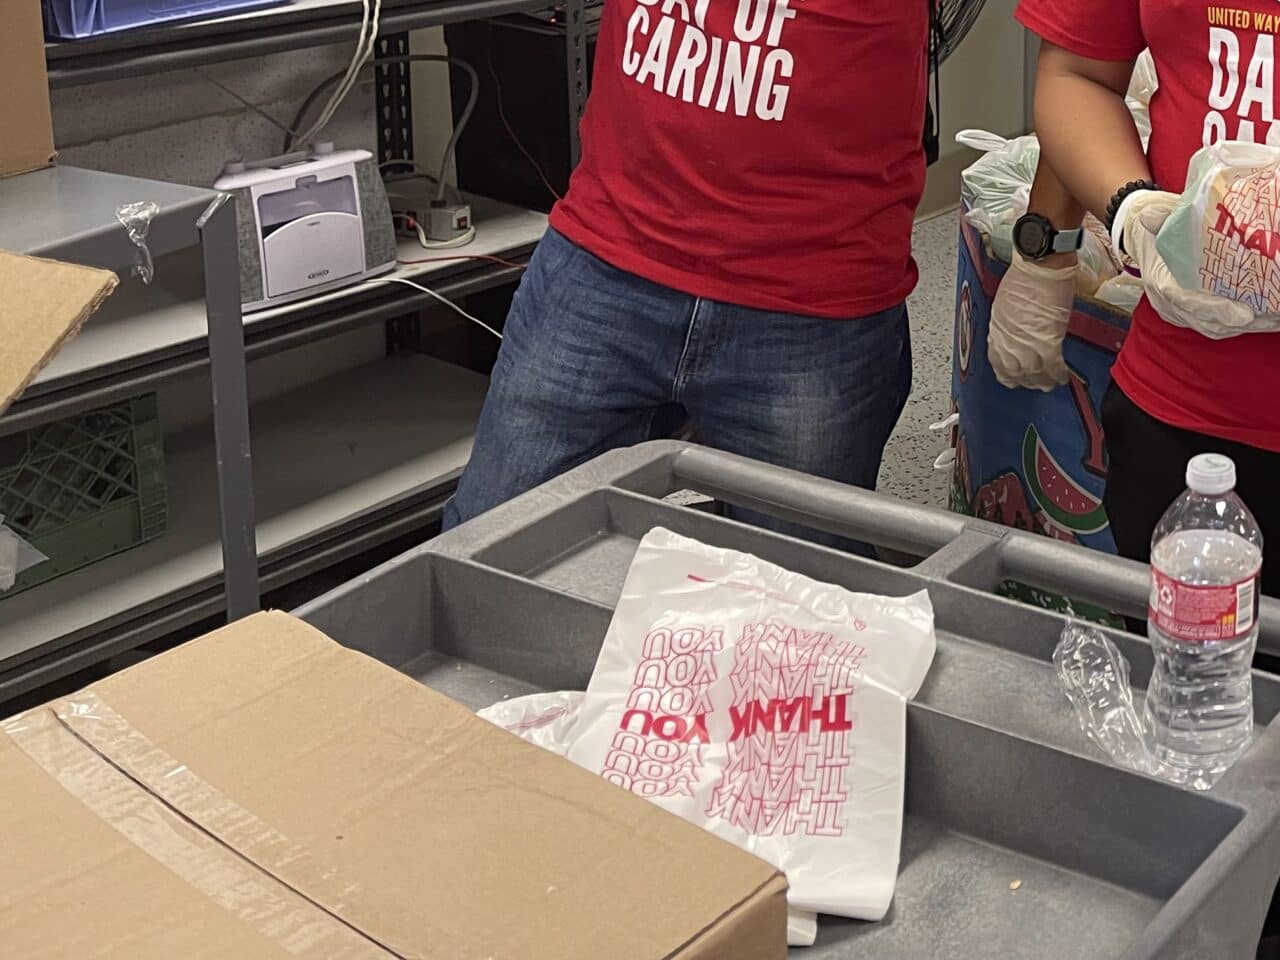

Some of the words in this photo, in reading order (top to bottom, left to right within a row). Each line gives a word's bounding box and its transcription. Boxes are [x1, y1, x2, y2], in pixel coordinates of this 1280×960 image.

[1207, 6, 1251, 29] UNITED
[622, 5, 794, 122] CARING
[642, 627, 725, 660] YOU
[634, 651, 719, 689] YOU
[626, 685, 715, 717] YOU
[729, 694, 854, 742] THANK
[619, 709, 711, 744] YOU
[604, 749, 700, 783] YOU
[612, 731, 704, 768] YOU
[726, 729, 851, 773] THANK
[715, 761, 848, 802] THANK
[704, 789, 844, 837] THANK
